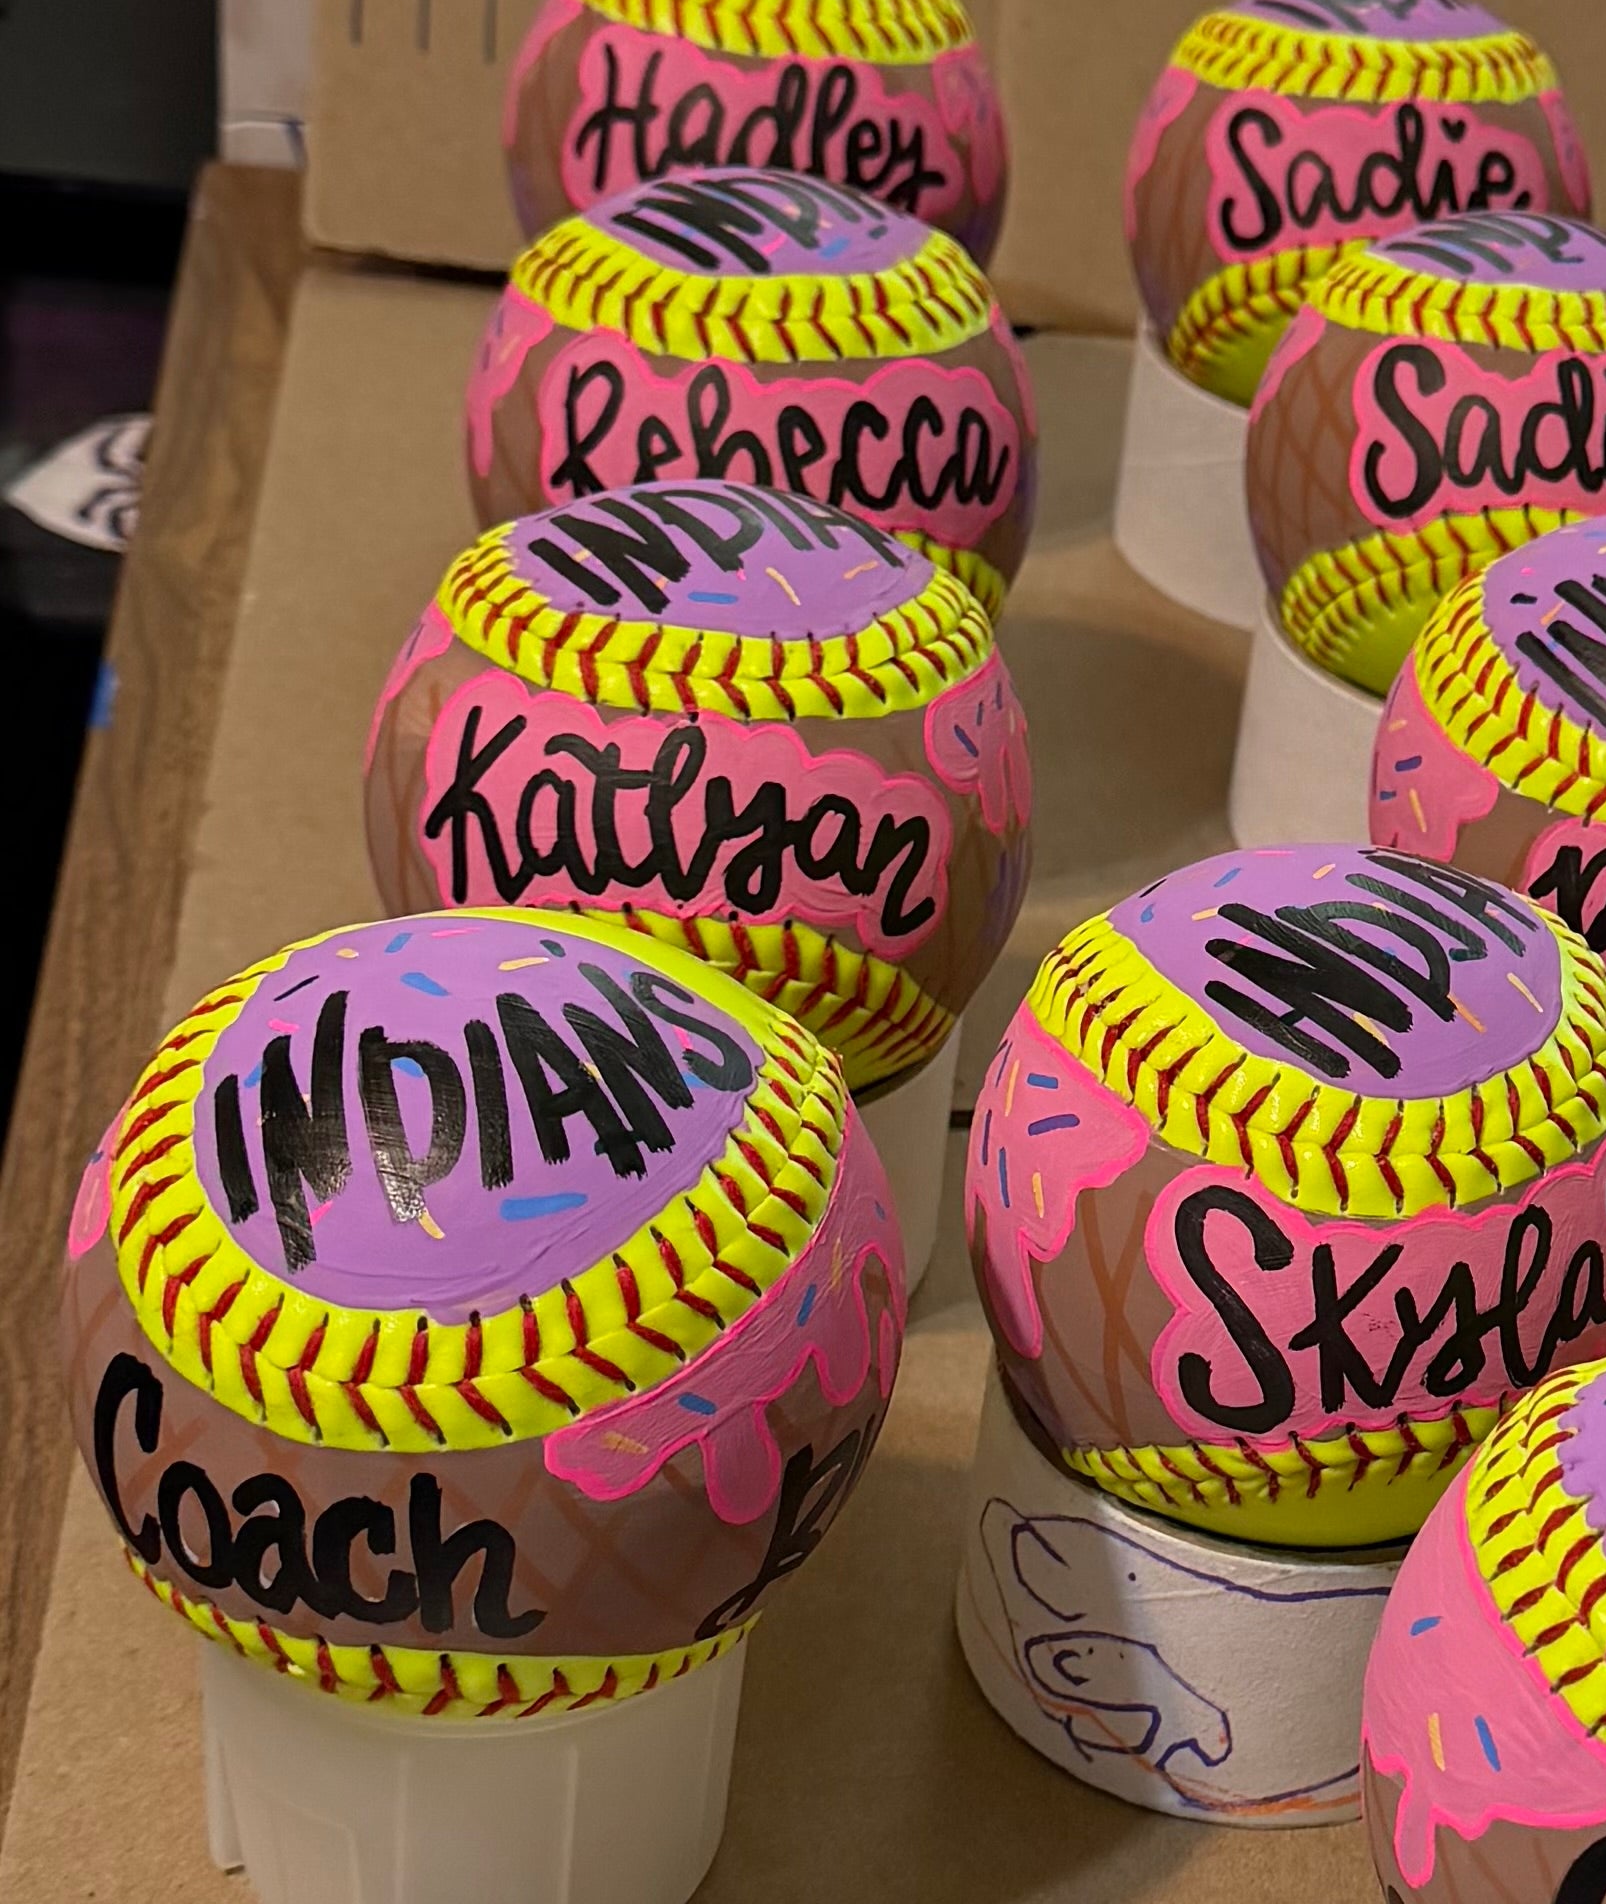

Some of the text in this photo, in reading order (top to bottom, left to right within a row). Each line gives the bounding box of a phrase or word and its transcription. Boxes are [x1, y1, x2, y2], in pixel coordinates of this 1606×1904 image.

[575, 42, 946, 212] Hadley
[1220, 103, 1532, 252] Sadie
[551, 360, 1010, 509] Rebecca
[528, 483, 905, 615] INDIA
[214, 962, 761, 1274] INDIANS
[93, 1351, 548, 1641] Coach
